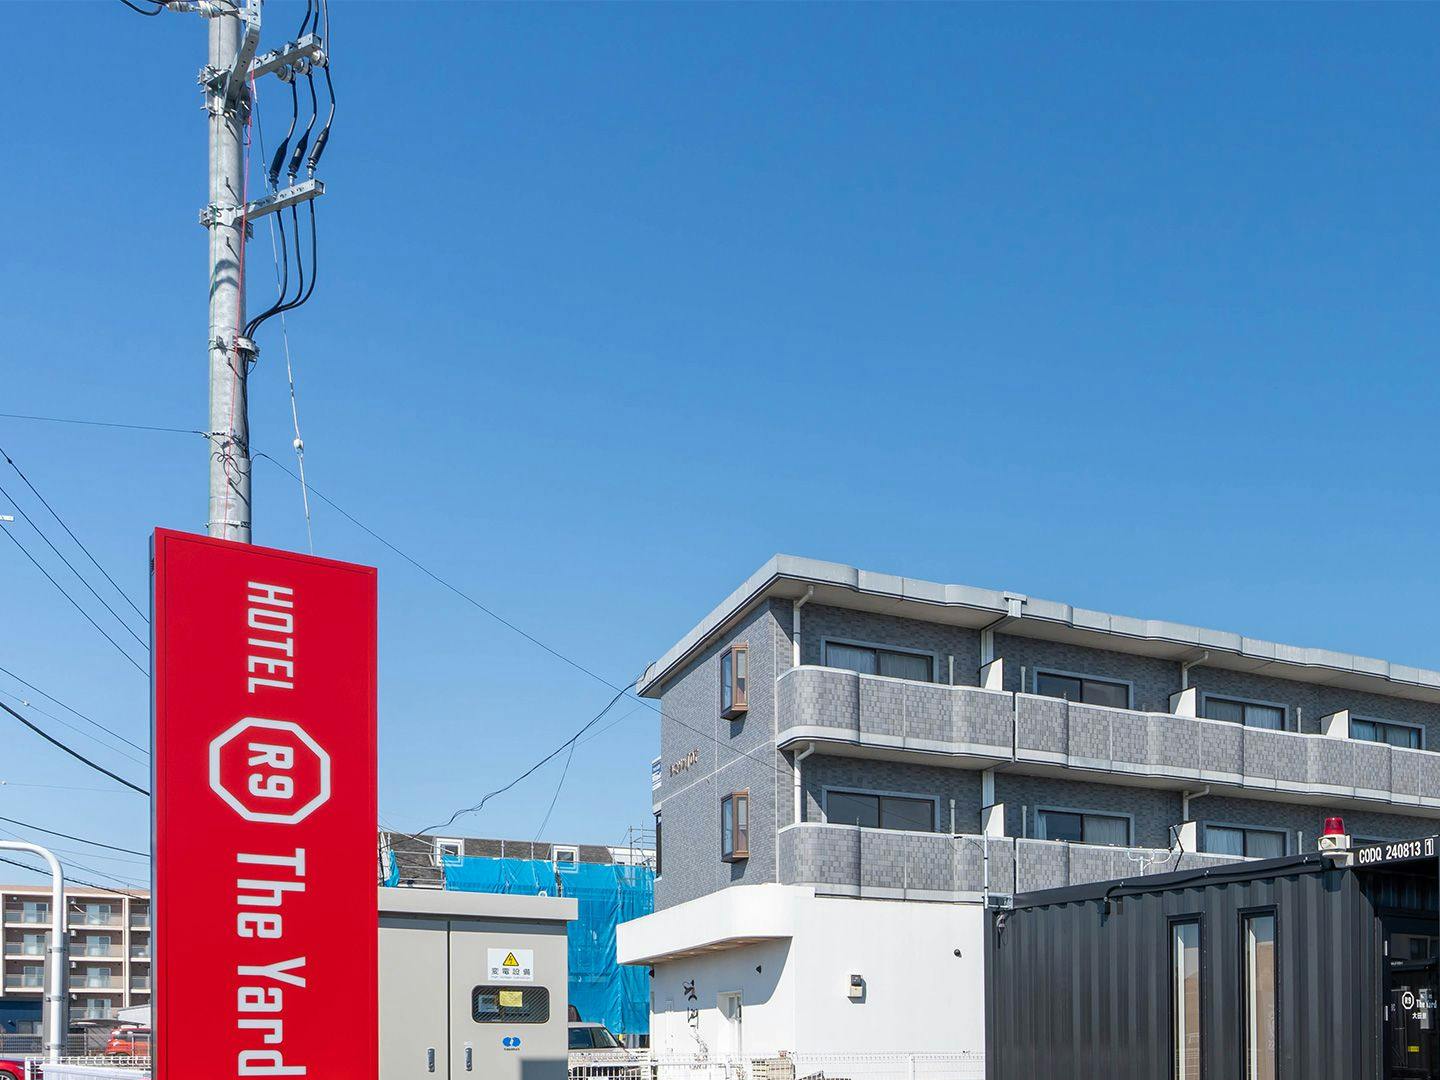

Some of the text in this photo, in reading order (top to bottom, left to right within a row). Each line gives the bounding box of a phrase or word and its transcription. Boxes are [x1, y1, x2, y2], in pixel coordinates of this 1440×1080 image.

[236, 580, 307, 1077] HOTEL R9 The Yard
[1359, 846, 1382, 864] CODQ
[1385, 840, 1421, 860] 240813
